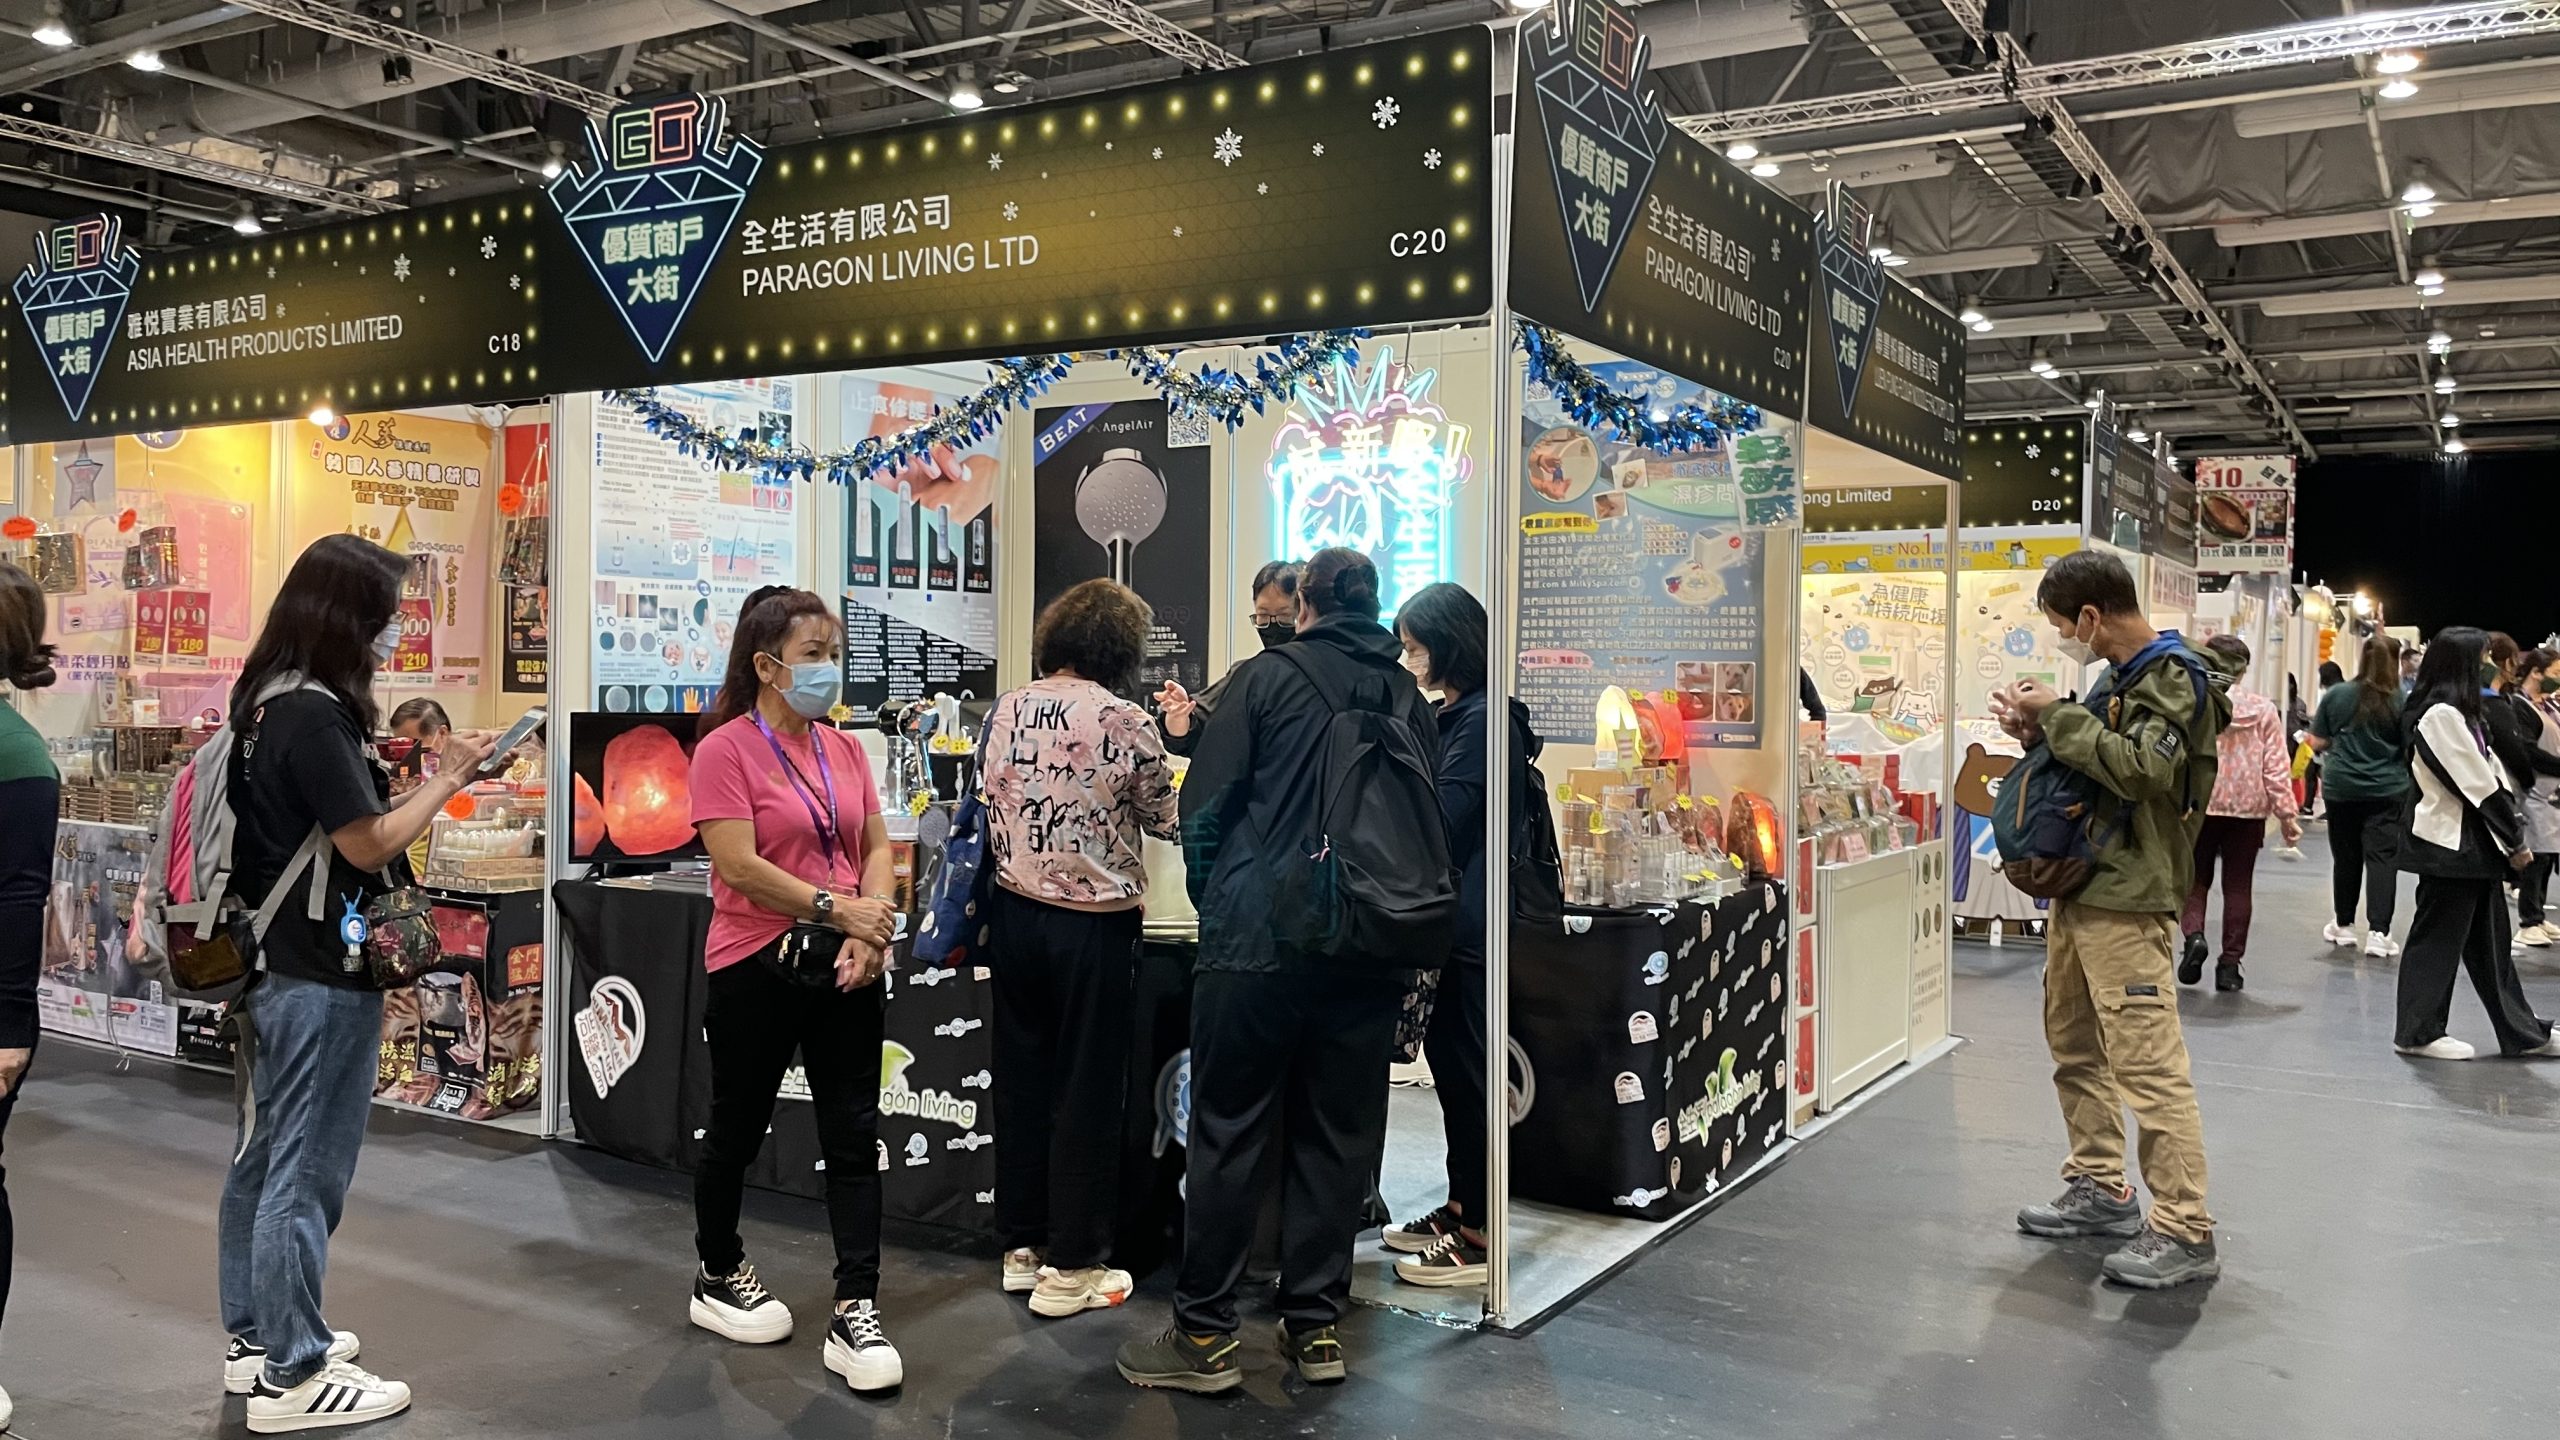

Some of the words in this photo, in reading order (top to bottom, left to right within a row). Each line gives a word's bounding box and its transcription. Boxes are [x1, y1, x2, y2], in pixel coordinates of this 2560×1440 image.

[613, 100, 698, 170] GO
[742, 195, 949, 255] 全生活有限公司
[1574, 193, 1610, 247] 大街
[1390, 228, 1446, 257] C20
[1648, 194, 1750, 281] 全生活有限公司
[742, 254, 873, 296] PARAGON
[883, 243, 975, 282] LIVING
[985, 235, 1039, 269] LTD
[628, 266, 679, 304] 大街
[1645, 247, 1714, 306] PARAGON
[1717, 282, 1757, 326] LIVING
[1760, 304, 1781, 337] LTD
[127, 344, 162, 371] ASIA
[165, 337, 227, 366] HEALTH
[231, 324, 327, 357] PRODUCTS
[331, 314, 402, 346] LIMITED
[488, 334, 521, 354] C18
[1774, 347, 1791, 370] C20
[59, 348, 91, 376] 大街
[1040, 408, 1087, 452] BEAT
[1103, 420, 1153, 433] AngelAir
[1837, 488, 1891, 504] Limited
[2032, 500, 2061, 511] D20
[1871, 583, 1929, 605] 為健康
[510, 947, 540, 965] 金門
[924, 1092, 974, 1124] living
